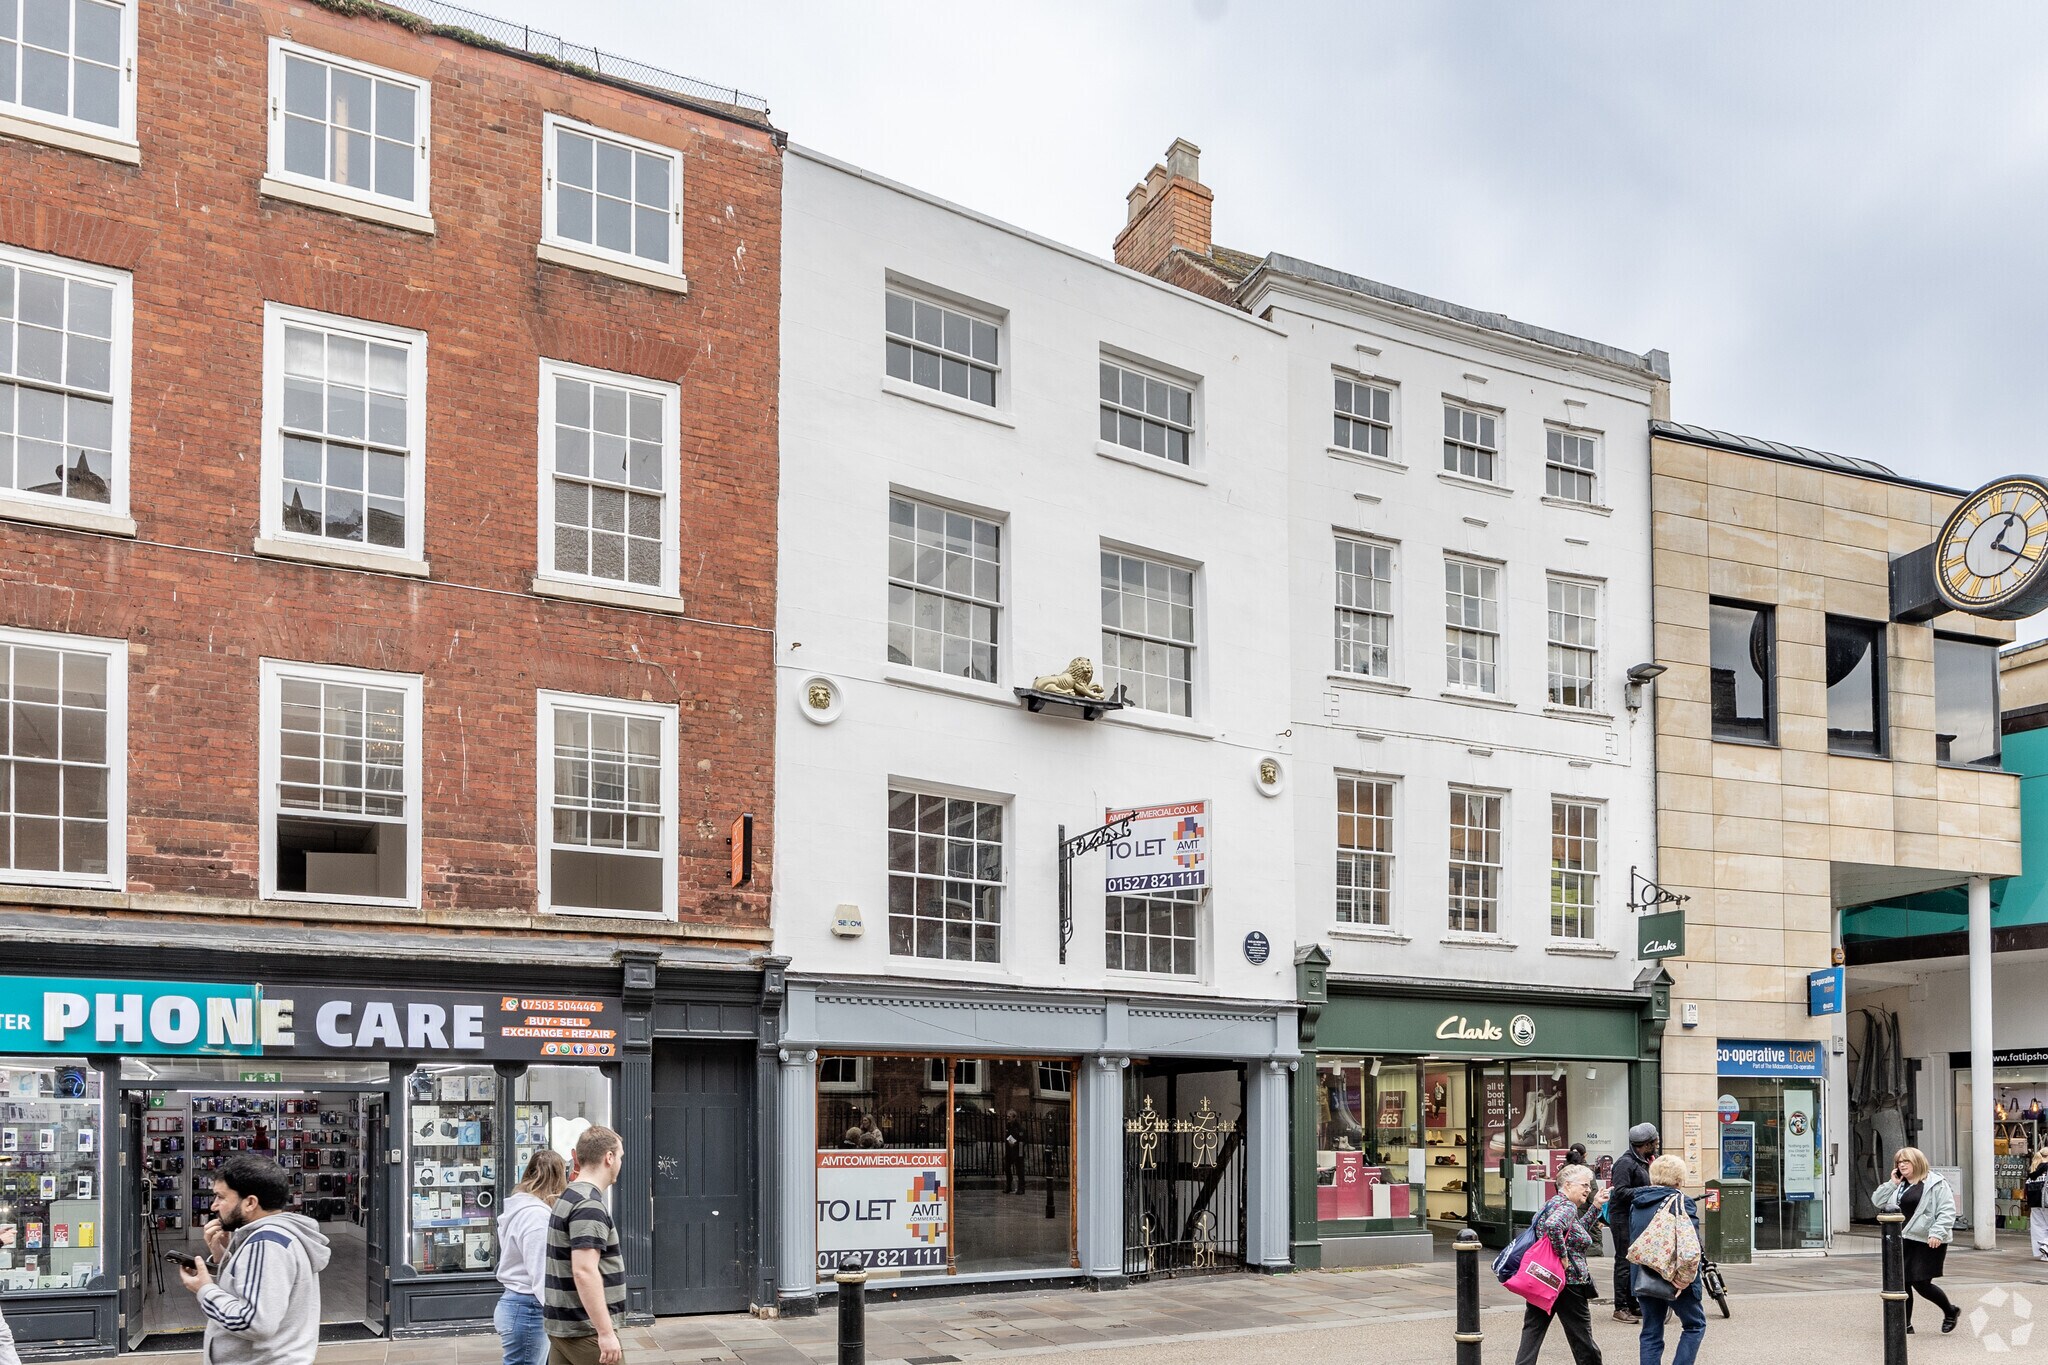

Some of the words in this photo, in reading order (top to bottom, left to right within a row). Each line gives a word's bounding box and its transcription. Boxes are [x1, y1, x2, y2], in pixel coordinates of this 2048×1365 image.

[1106, 842, 1131, 859] TO
[1136, 838, 1166, 857] LET
[1176, 840, 1200, 850] AMT
[1108, 877, 1148, 891] 01527
[1151, 874, 1174, 887] 821
[1178, 872, 1200, 885] 111
[1643, 940, 1677, 953] Clarks
[521, 1000, 554, 1010] 07503
[557, 1001, 596, 1011] 504446
[44, 992, 294, 1046] PHONE
[316, 1000, 484, 1049] CARE
[529, 1017, 552, 1025] BUY
[560, 1018, 585, 1026] SELL
[502, 1028, 563, 1037] EXCHANGE
[572, 1030, 610, 1038] REPAIR
[1436, 1015, 1503, 1040] Clarks
[1788, 1047, 1815, 1062] travel
[1993, 1052, 2048, 1062] ww.fatlipsho
[1380, 1114, 1398, 1124] £65
[821, 1156, 942, 1165] AMTCOMMERCIAL.CO.UK
[818, 1200, 850, 1222] TO
[856, 1199, 896, 1220] LET
[912, 1204, 942, 1216] AMT
[877, 1250, 907, 1266] 821
[915, 1249, 940, 1265] 111
